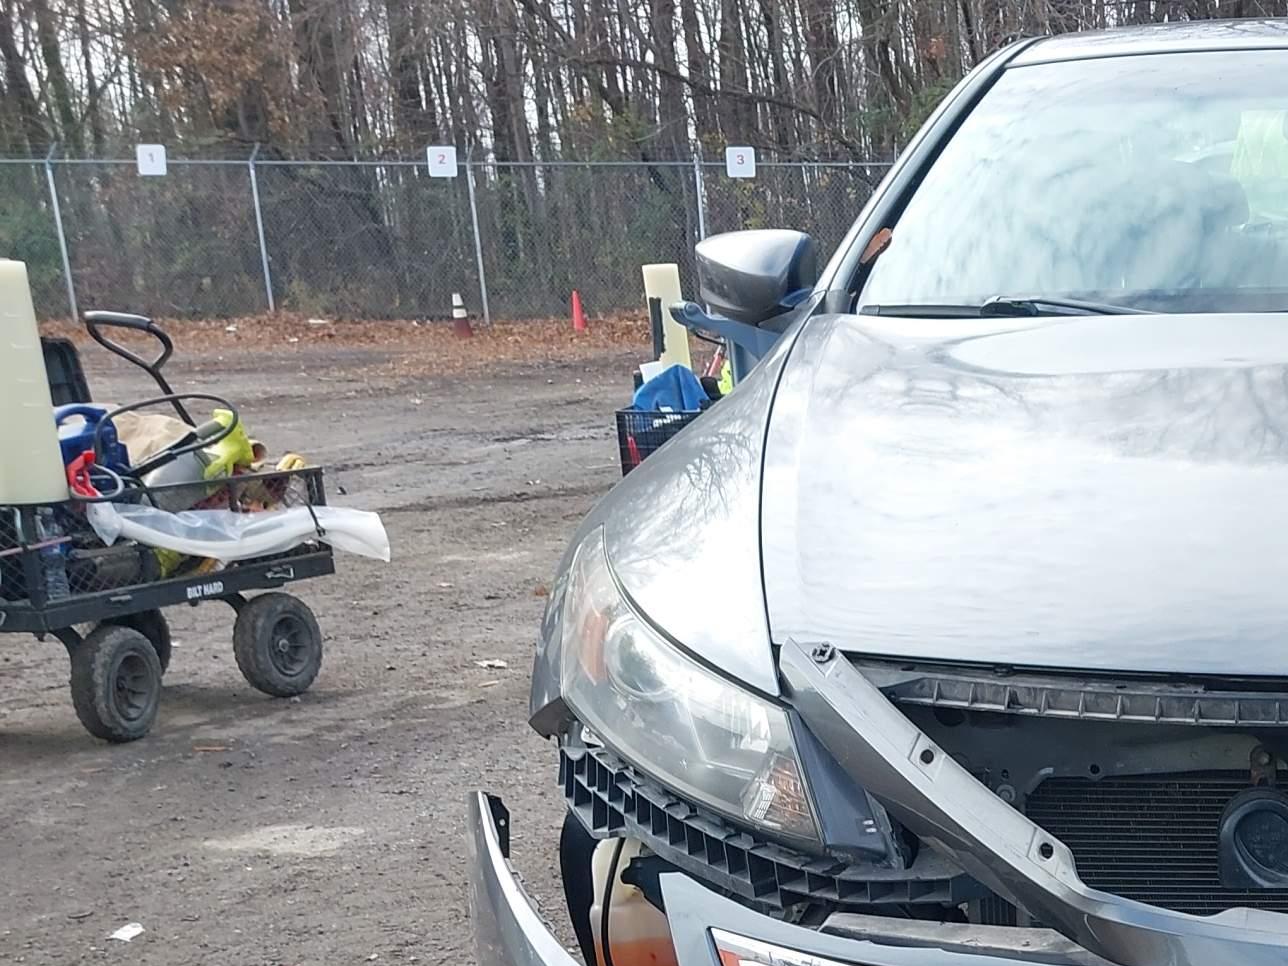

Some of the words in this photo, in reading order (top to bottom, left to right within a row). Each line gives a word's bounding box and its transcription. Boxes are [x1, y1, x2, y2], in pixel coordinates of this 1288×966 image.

[437, 154, 446, 165] 2
[736, 154, 745, 164] 3
[203, 581, 224, 596] HARD
